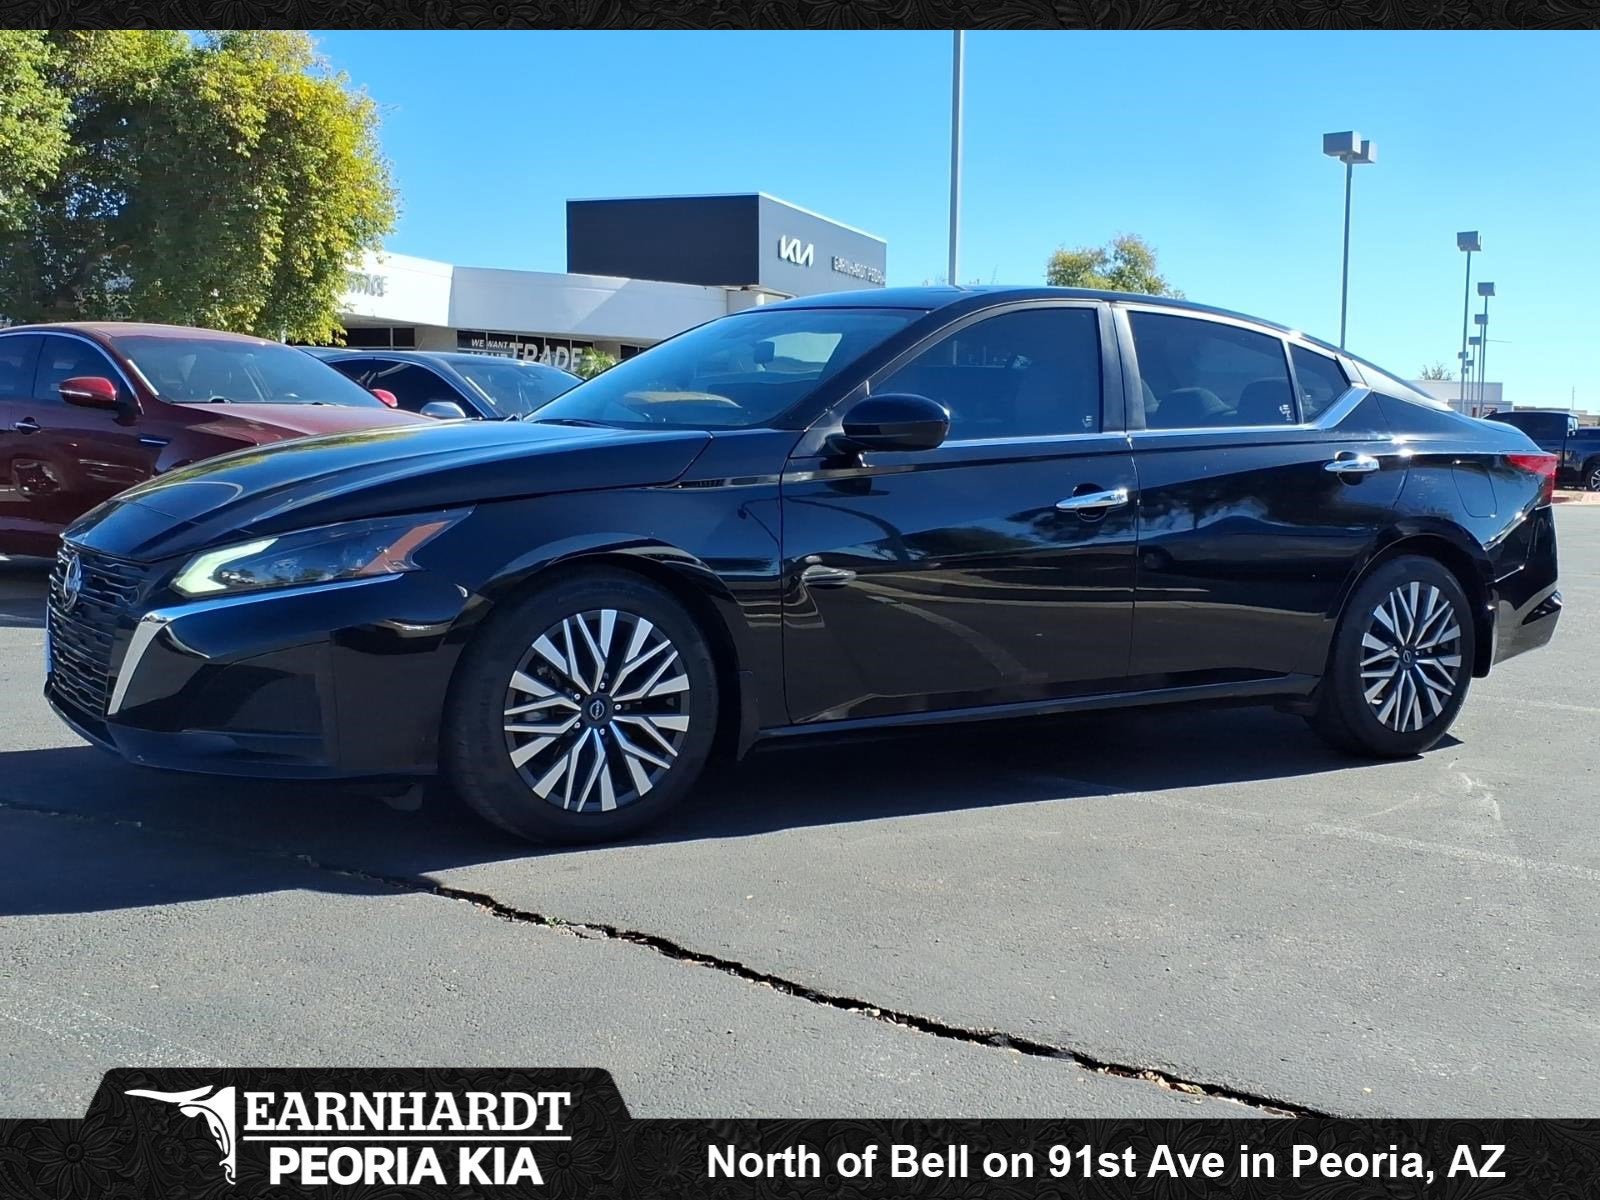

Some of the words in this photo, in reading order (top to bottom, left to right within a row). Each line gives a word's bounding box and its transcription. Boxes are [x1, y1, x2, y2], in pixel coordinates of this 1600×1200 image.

[471, 338, 485, 348] WE
[487, 340, 508, 349] WANT
[509, 342, 583, 372] TRADE
